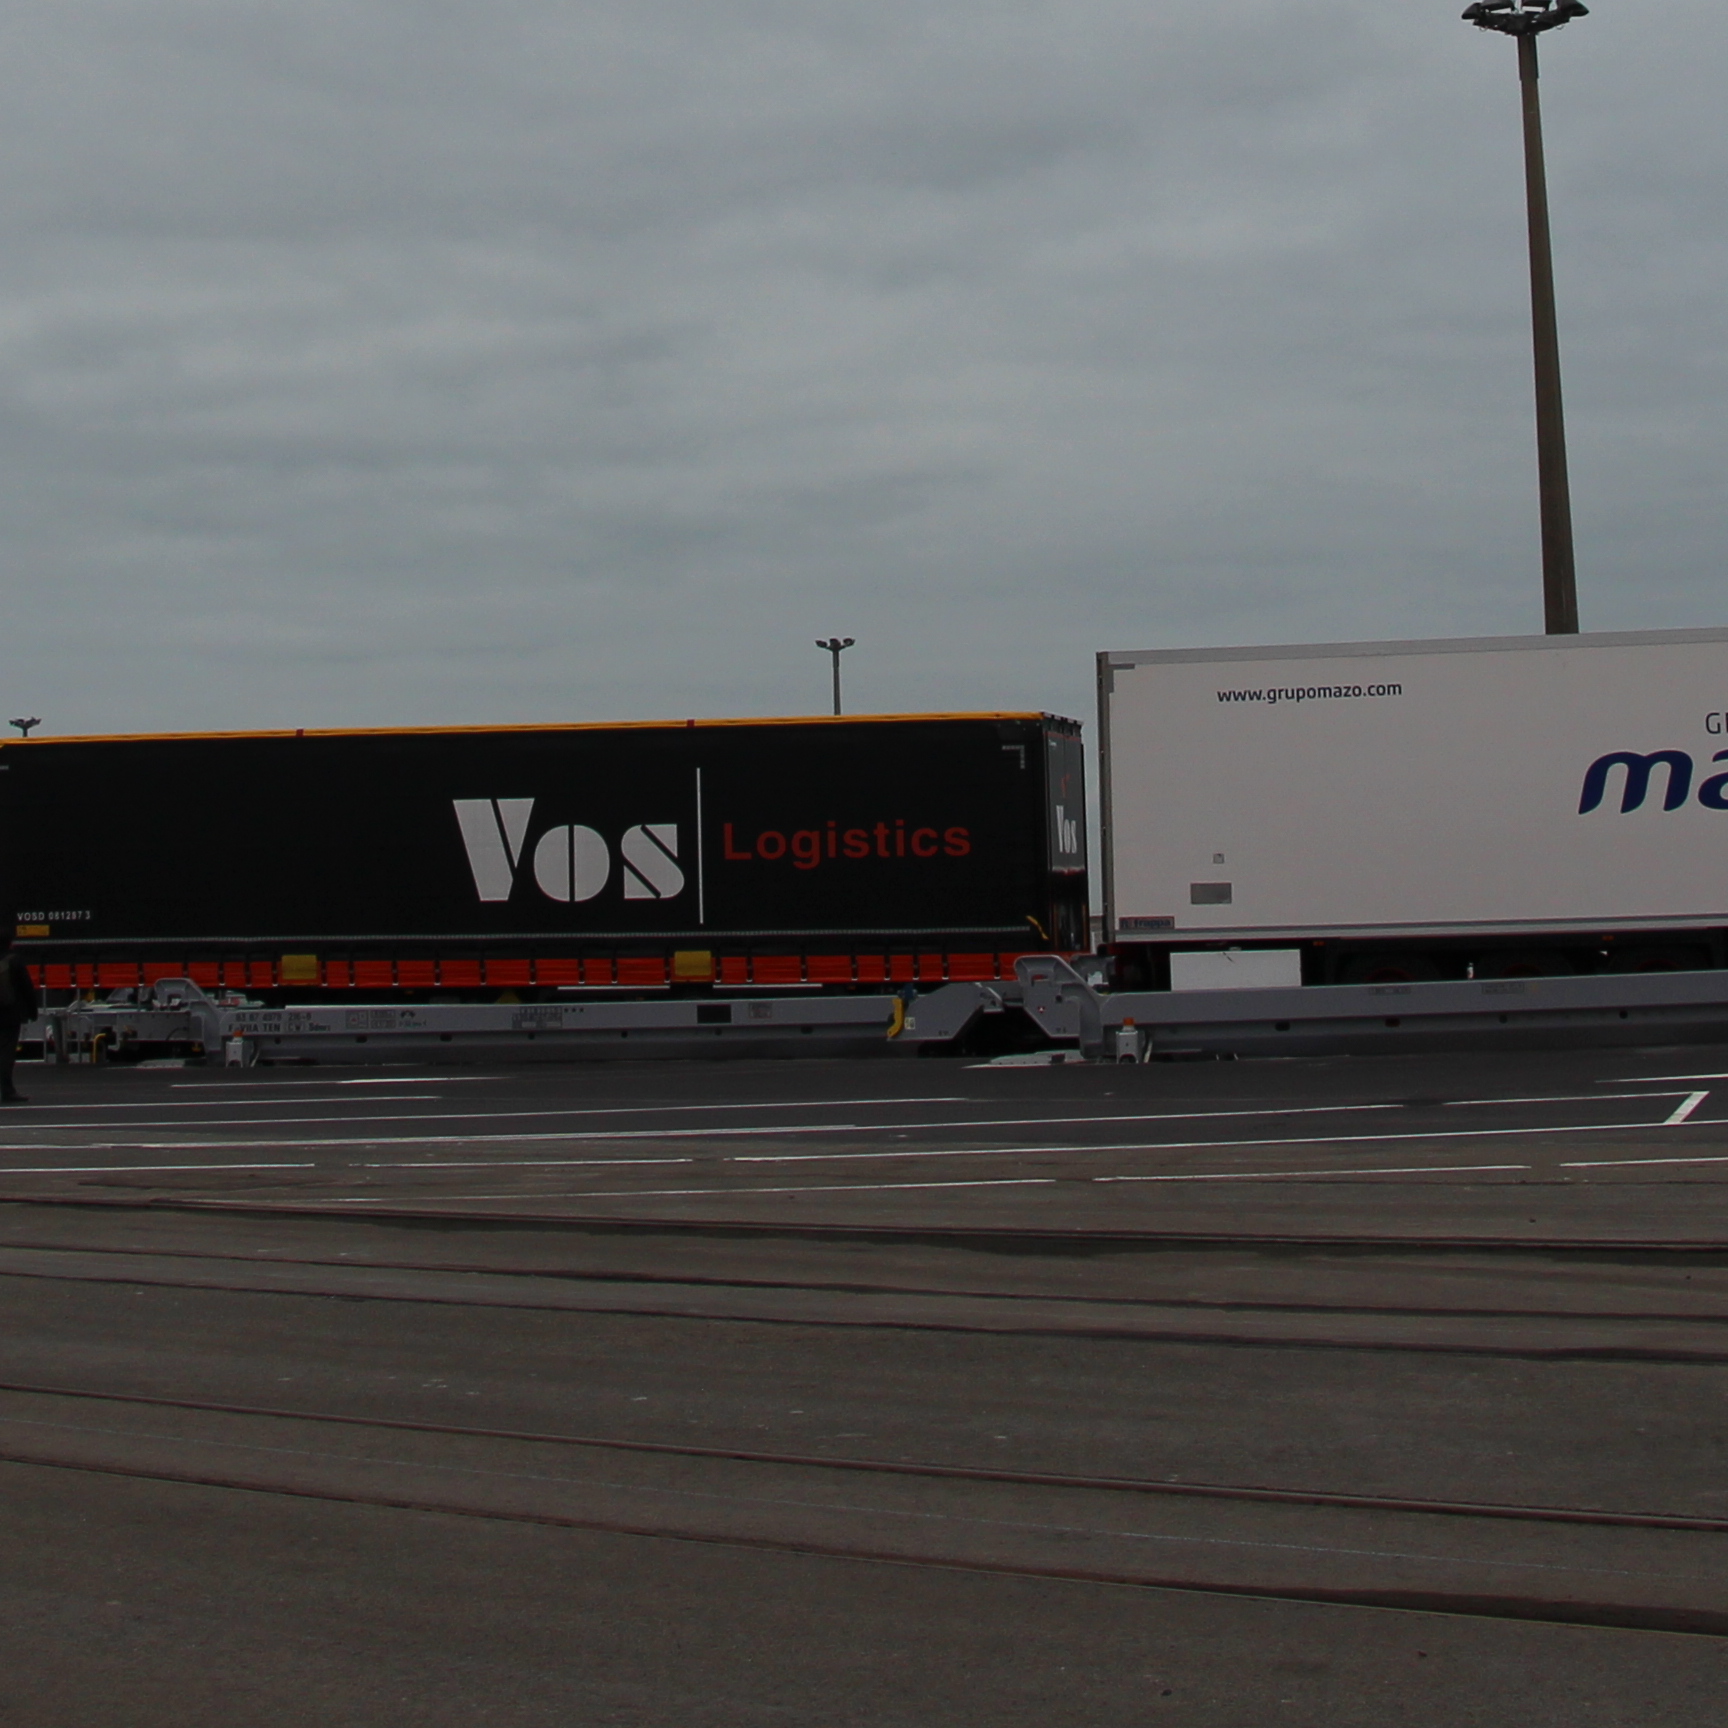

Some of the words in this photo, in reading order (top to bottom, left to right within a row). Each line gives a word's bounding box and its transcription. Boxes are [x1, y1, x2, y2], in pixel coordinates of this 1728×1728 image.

[1216, 683, 1403, 704] www.grupomazo.com
[452, 796, 686, 903] Vos
[722, 818, 971, 870] Logistics
[17, 912, 45, 921] VOSD
